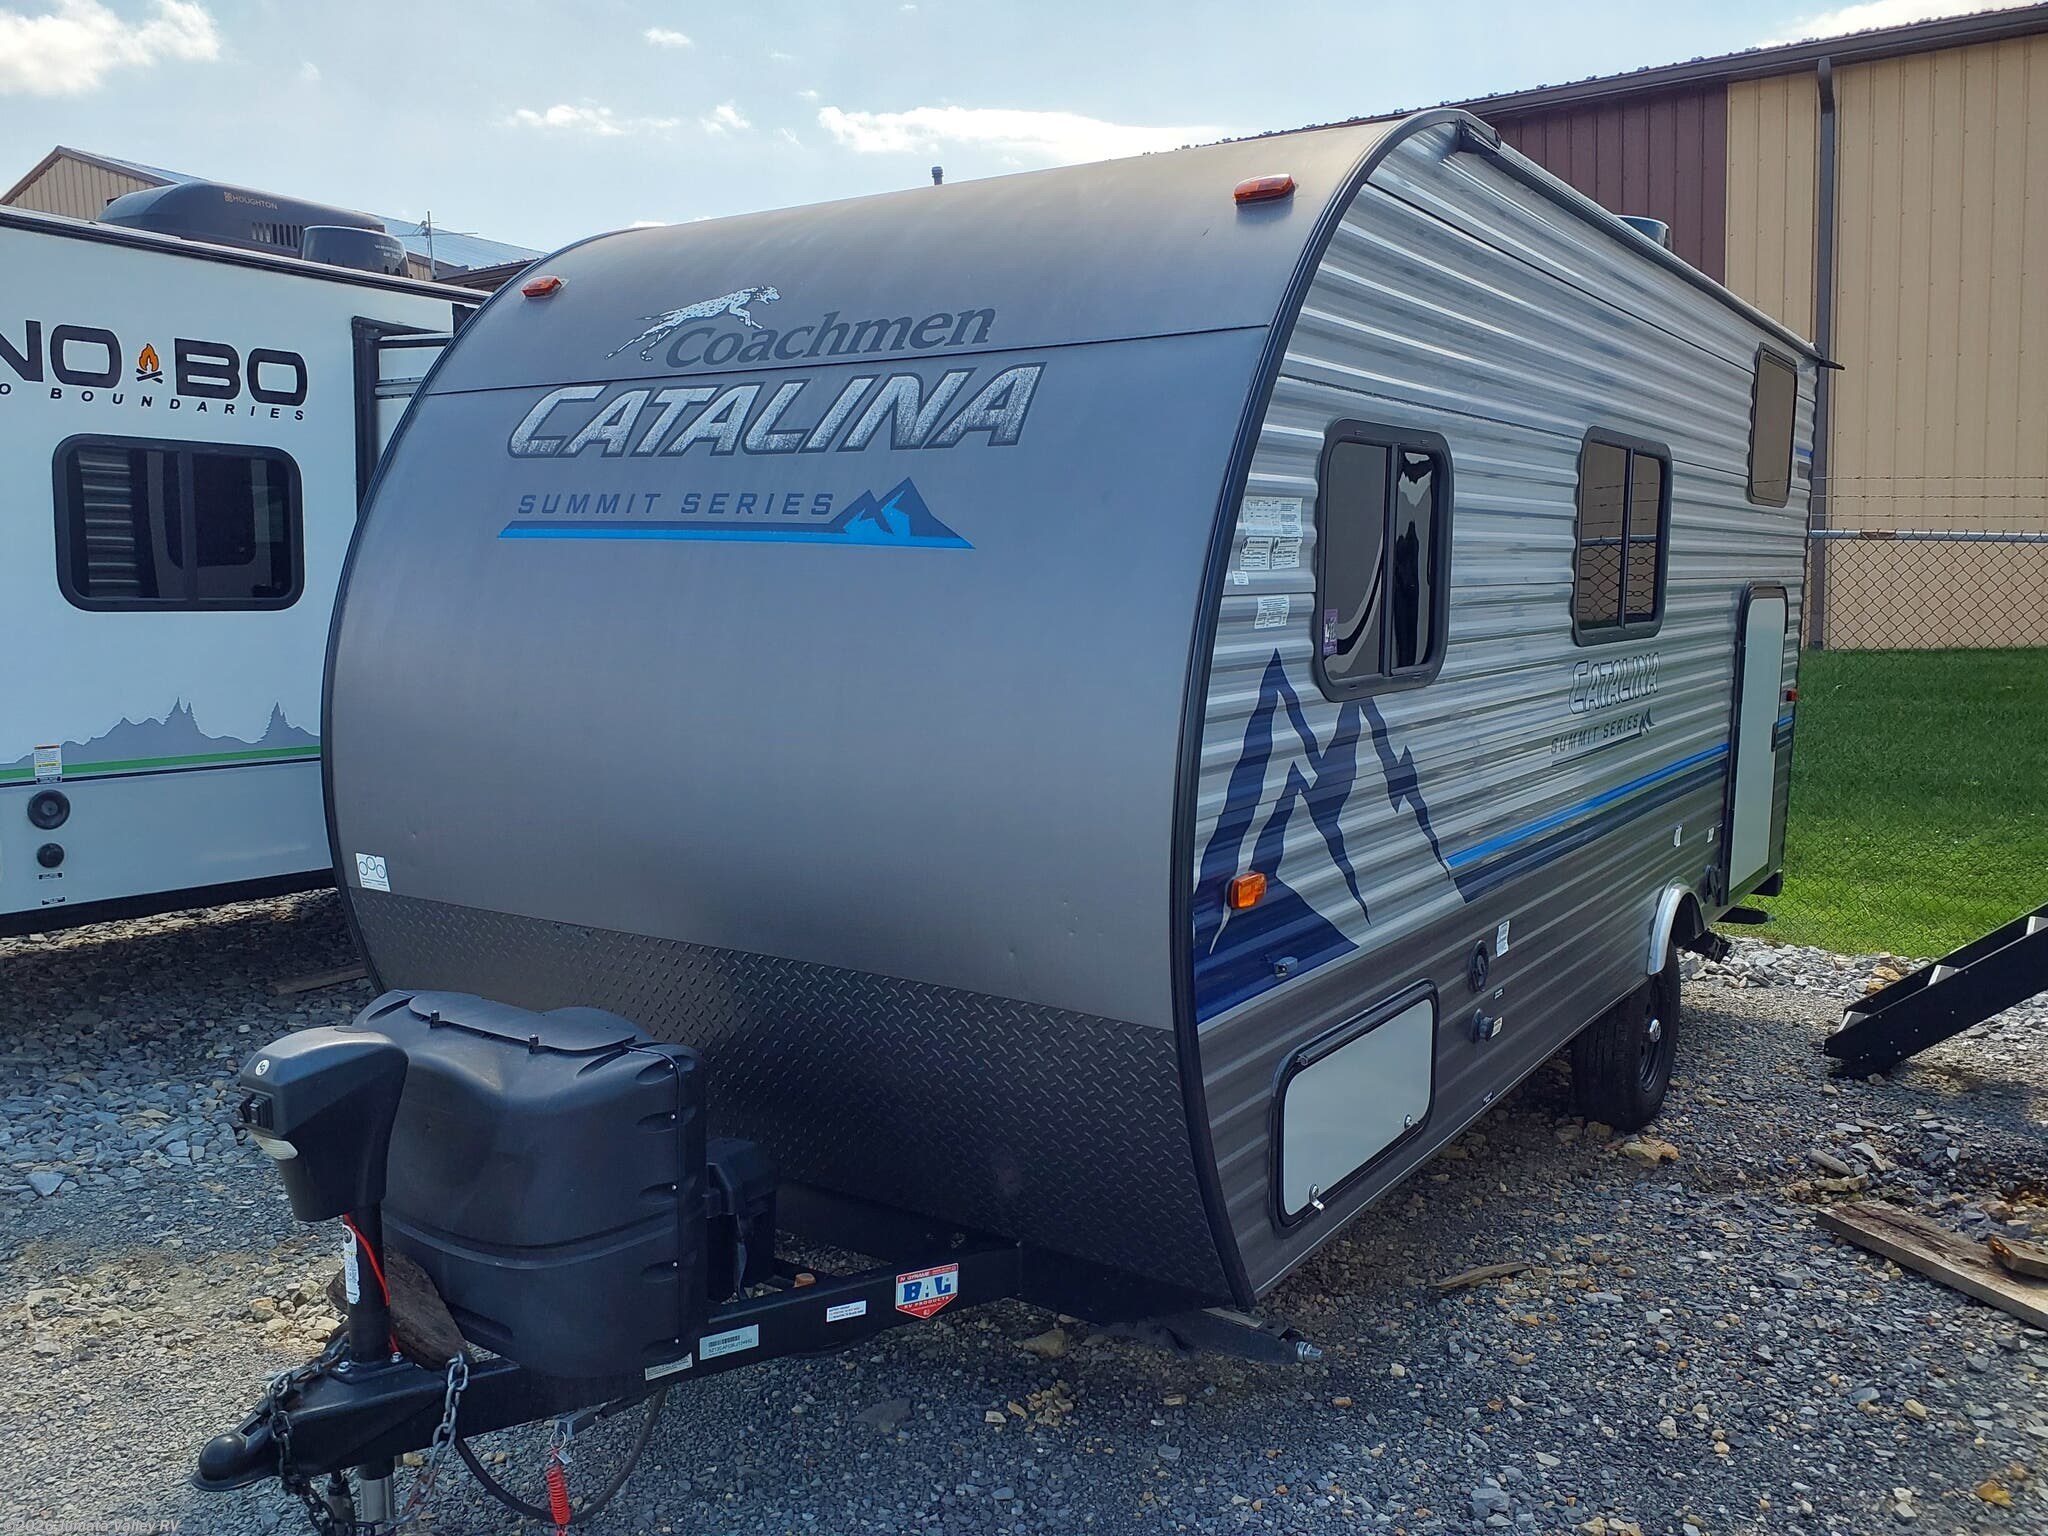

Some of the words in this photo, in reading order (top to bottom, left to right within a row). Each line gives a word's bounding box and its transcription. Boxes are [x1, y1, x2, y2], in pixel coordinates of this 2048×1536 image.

[665, 307, 996, 369] Coachmen
[50, 386, 305, 421] BOUNDARIES
[507, 361, 1048, 459] CATALINA
[518, 493, 661, 514] SUMMIT
[681, 492, 835, 516] SERIES
[1568, 652, 1660, 715] CATALINA
[1551, 726, 1599, 754] SUMMIT
[1603, 713, 1639, 739] SERIES
[903, 1276, 951, 1303] BAL
